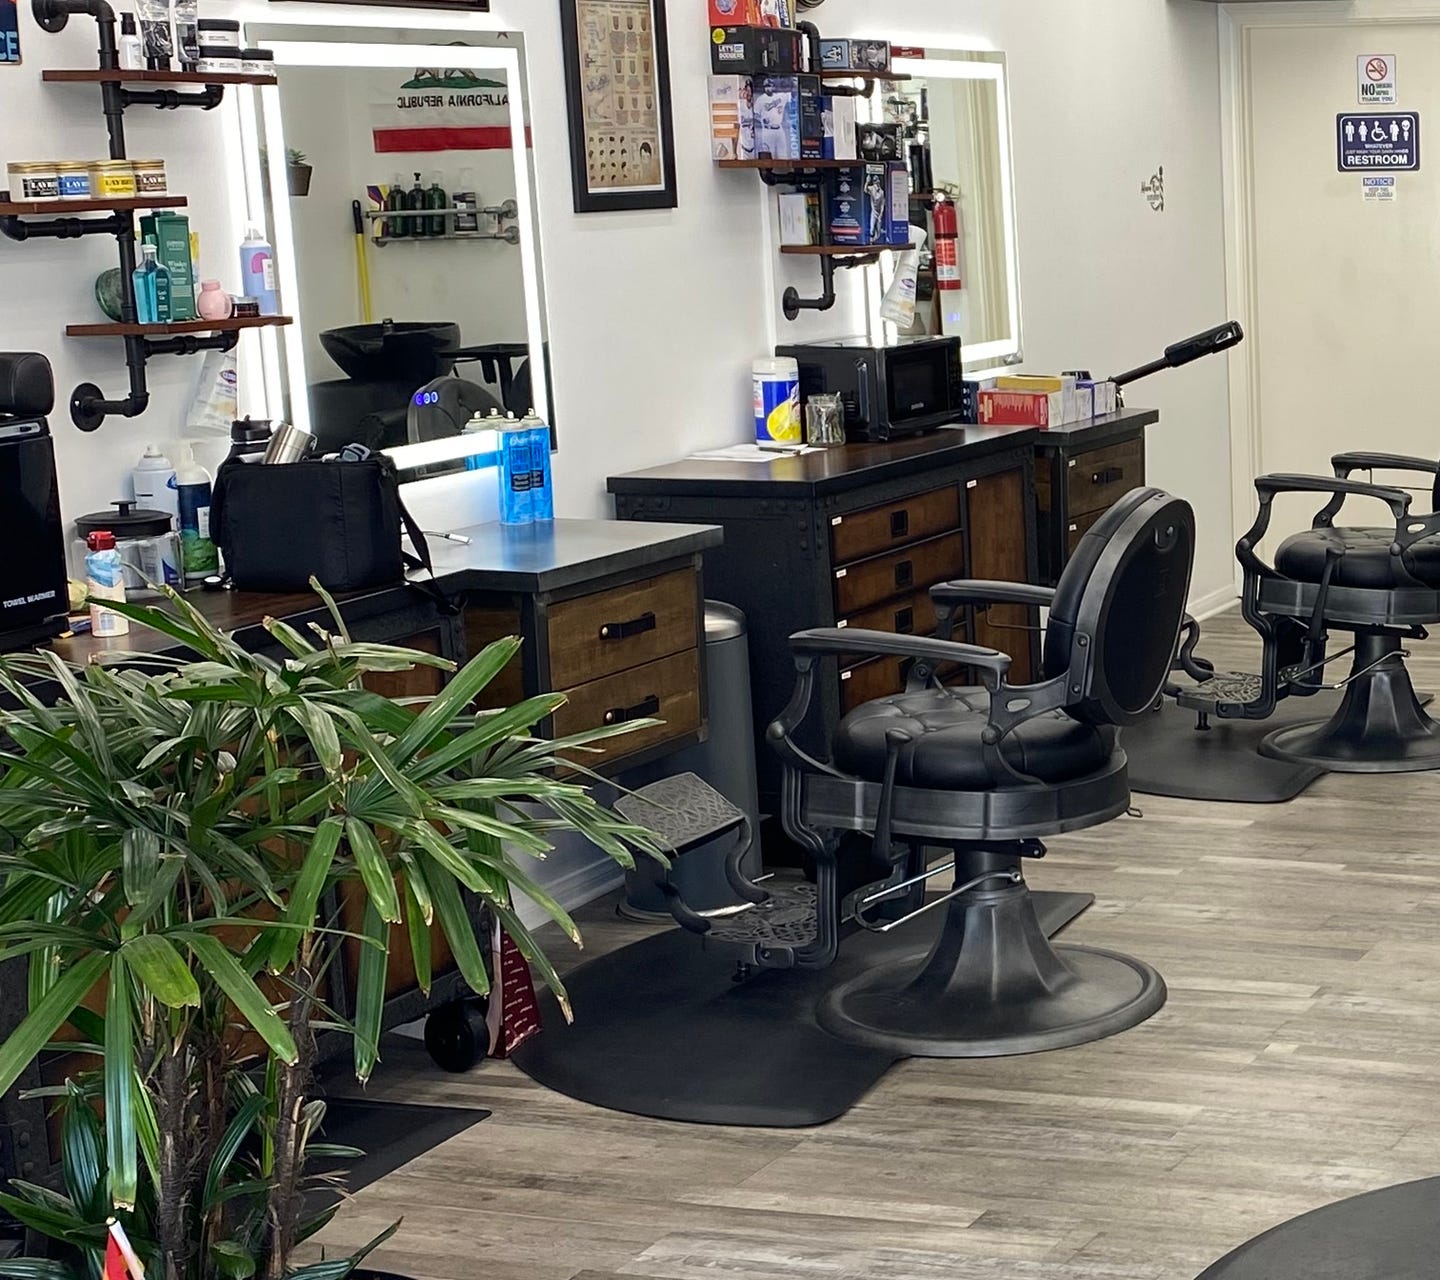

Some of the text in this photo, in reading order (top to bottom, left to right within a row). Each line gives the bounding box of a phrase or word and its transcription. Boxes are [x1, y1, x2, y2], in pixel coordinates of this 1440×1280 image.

[1361, 83, 1376, 96] NO
[1347, 154, 1409, 166] RESTROOM
[1364, 178, 1394, 186] NOTICE
[2, 589, 56, 609] TOWEL WARMER
